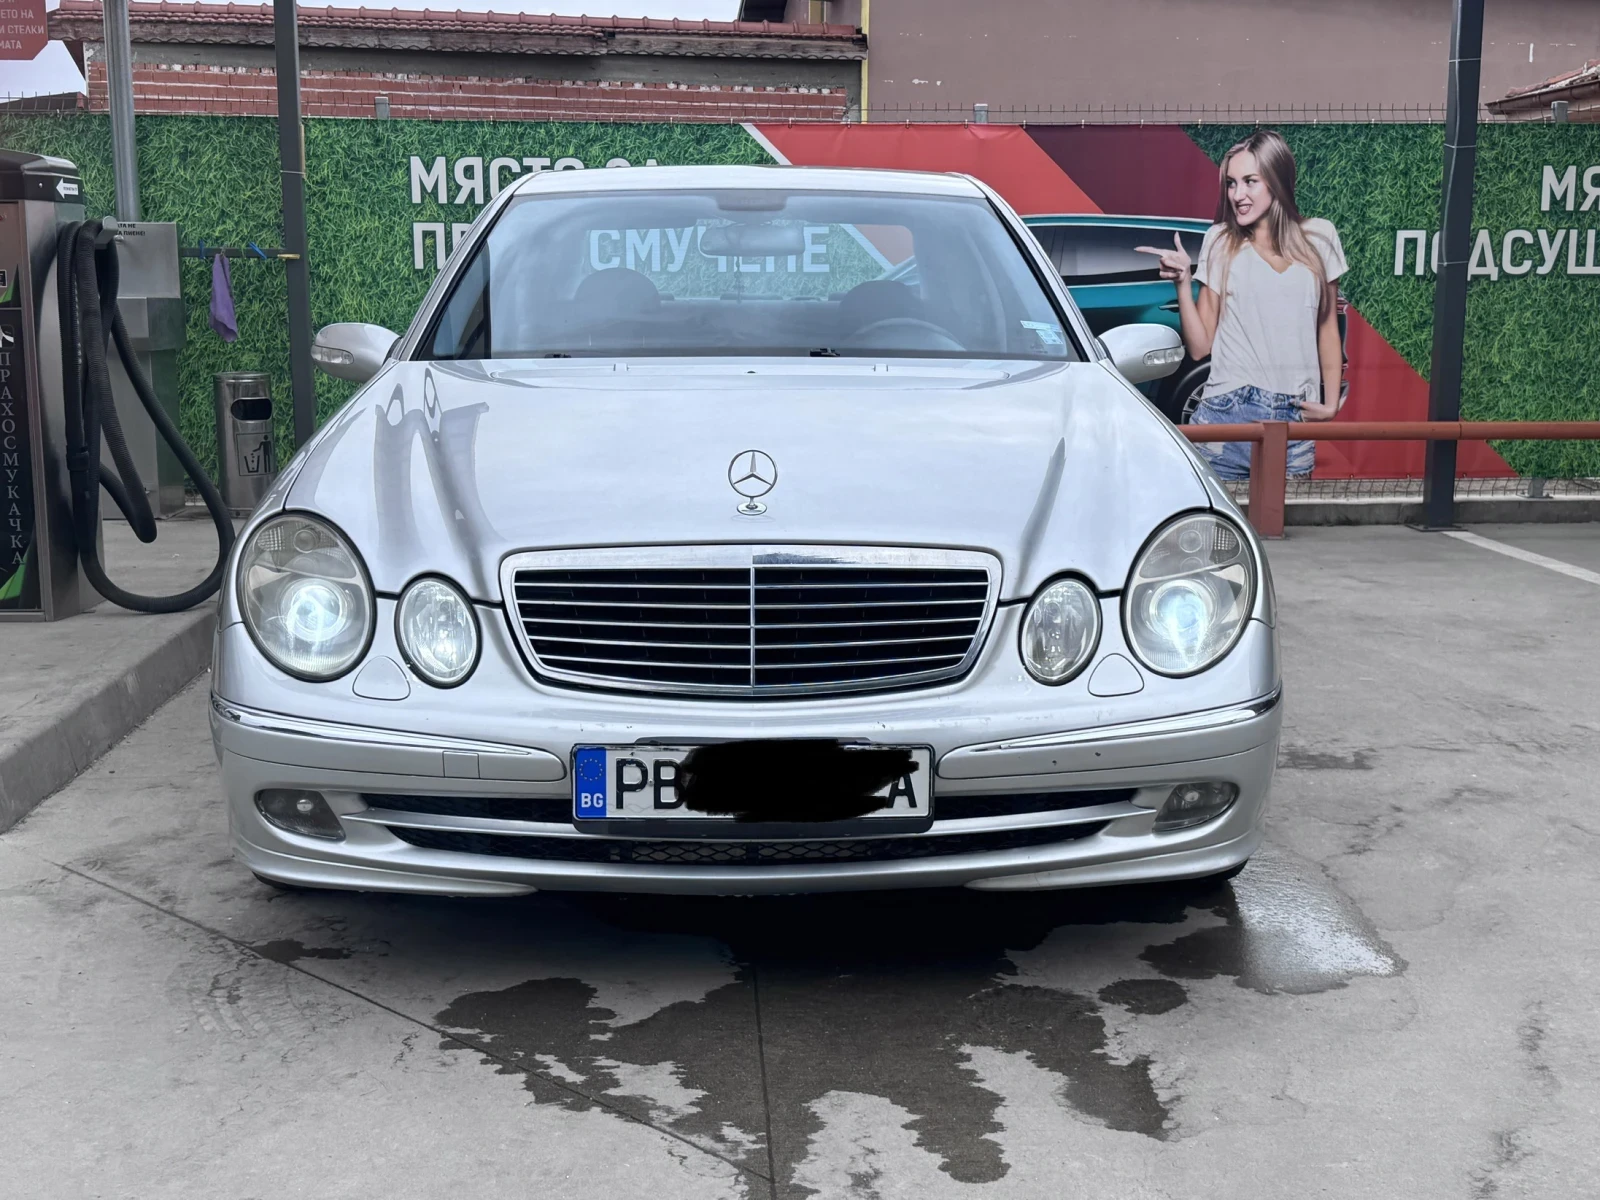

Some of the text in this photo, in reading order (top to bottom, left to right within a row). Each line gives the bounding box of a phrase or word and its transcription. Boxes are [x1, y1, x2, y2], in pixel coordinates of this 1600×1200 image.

[8, 24, 45, 34] СТЕЛКИ
[410, 156, 585, 205] МЯС
[1394, 228, 1600, 282] ПДСУШ
[0, 352, 24, 565] ПРАХОСМУКАЧКА
[581, 793, 604, 808] BG
